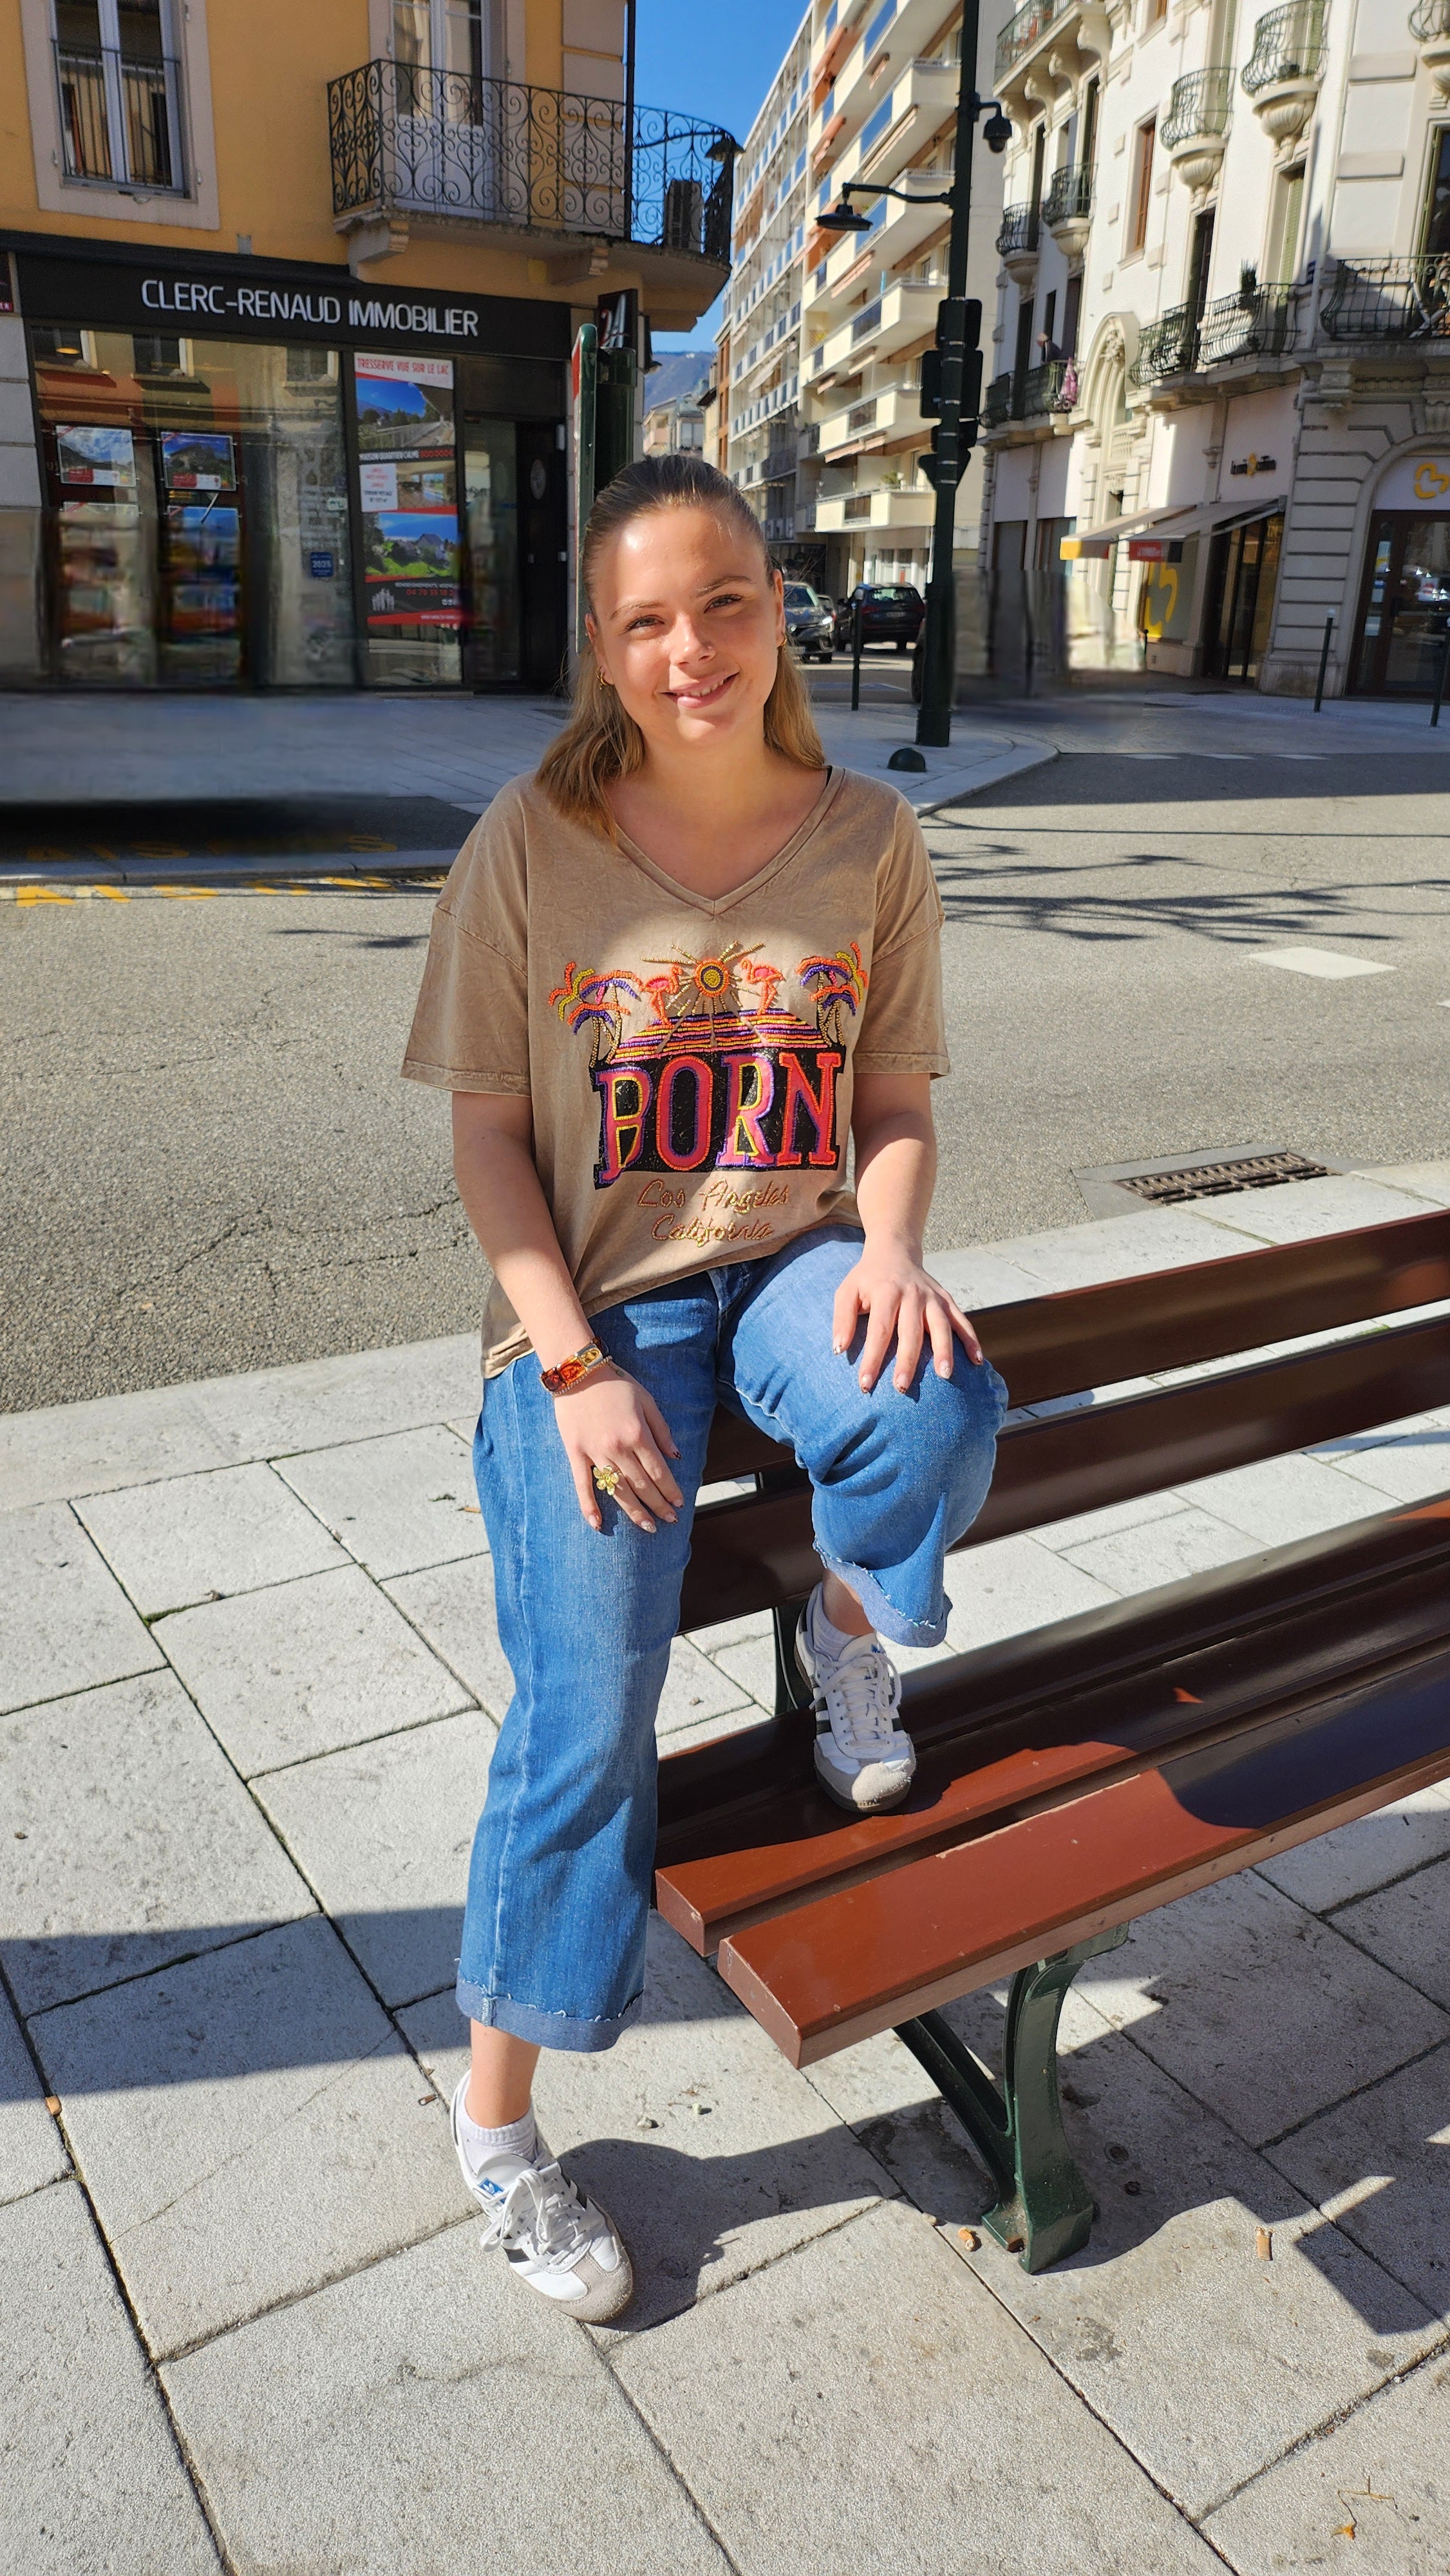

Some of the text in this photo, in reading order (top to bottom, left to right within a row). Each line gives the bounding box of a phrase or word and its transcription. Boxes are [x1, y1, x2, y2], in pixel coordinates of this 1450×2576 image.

[141, 279, 478, 337] CLERC-RENAUD IMMOBILIER
[397, 361, 410, 372] VUE
[412, 362, 426, 373] SUR
[428, 363, 435, 374] LE
[437, 365, 449, 375] LAC
[595, 1052, 842, 1184] BORN
[637, 1177, 789, 1215] Los Angeles
[652, 1213, 774, 1248] California
